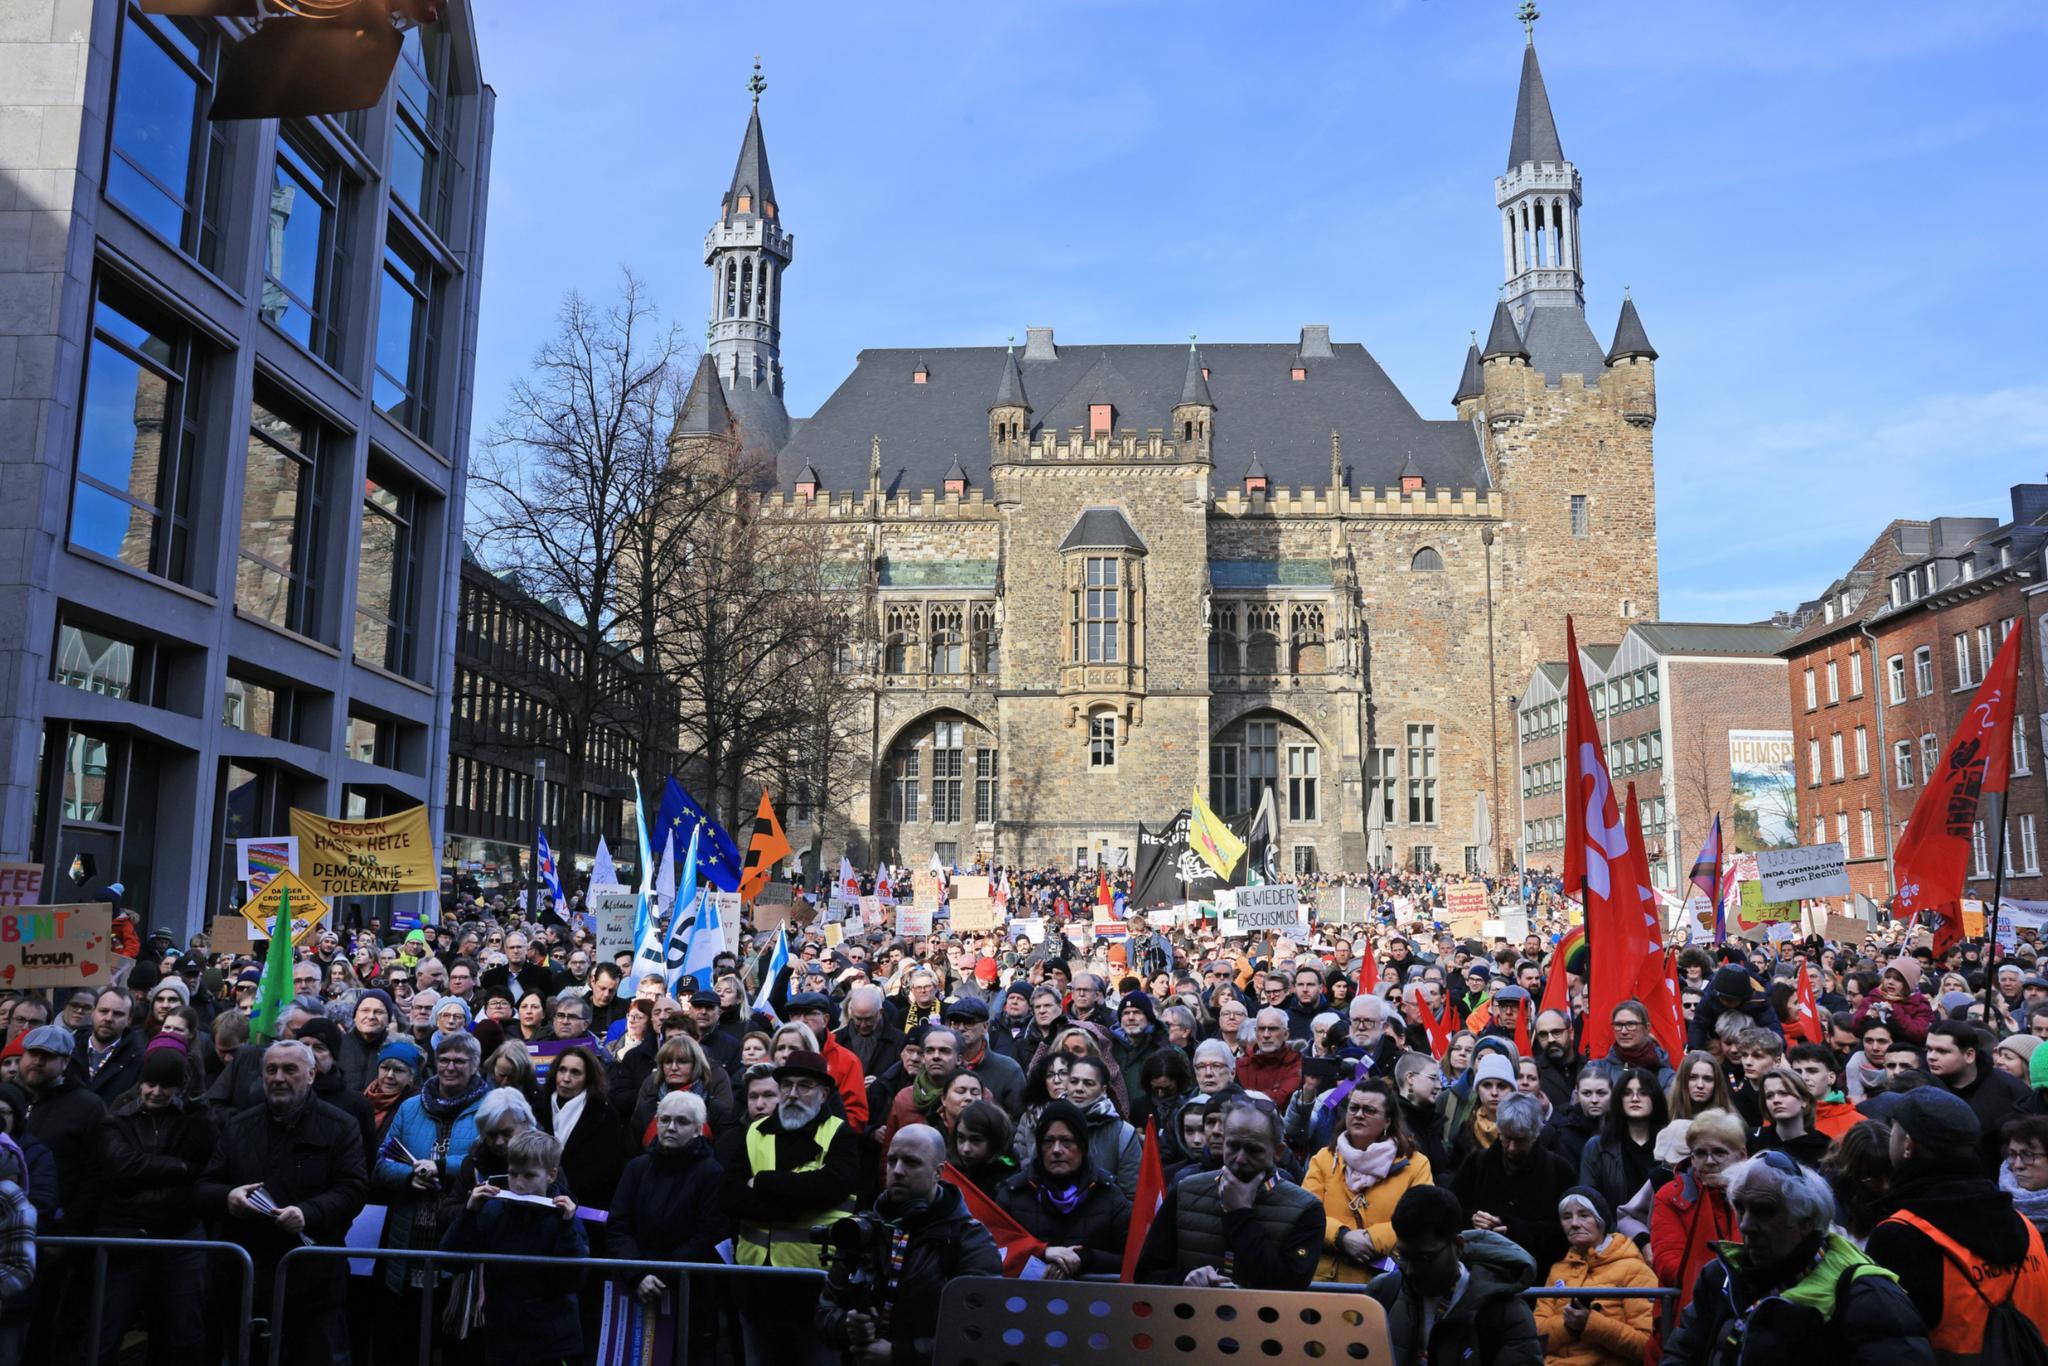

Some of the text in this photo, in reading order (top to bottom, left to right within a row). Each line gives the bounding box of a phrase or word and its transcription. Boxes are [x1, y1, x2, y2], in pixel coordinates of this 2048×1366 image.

[328, 821, 387, 836] GEGEN
[314, 834, 353, 853] HASS
[367, 833, 411, 852] HETZE
[313, 862, 402, 879] DEMOKRATIE
[1762, 861, 1844, 879] INDA-GYMNASIUM
[1776, 867, 1843, 889] gegen Rechts!
[320, 879, 401, 893] TOLERANZ
[1236, 889, 1295, 907] NIE WIEDER
[1, 911, 71, 944] BUNT
[1237, 909, 1299, 928] FASCHISMUS!
[21, 946, 74, 965] braun
